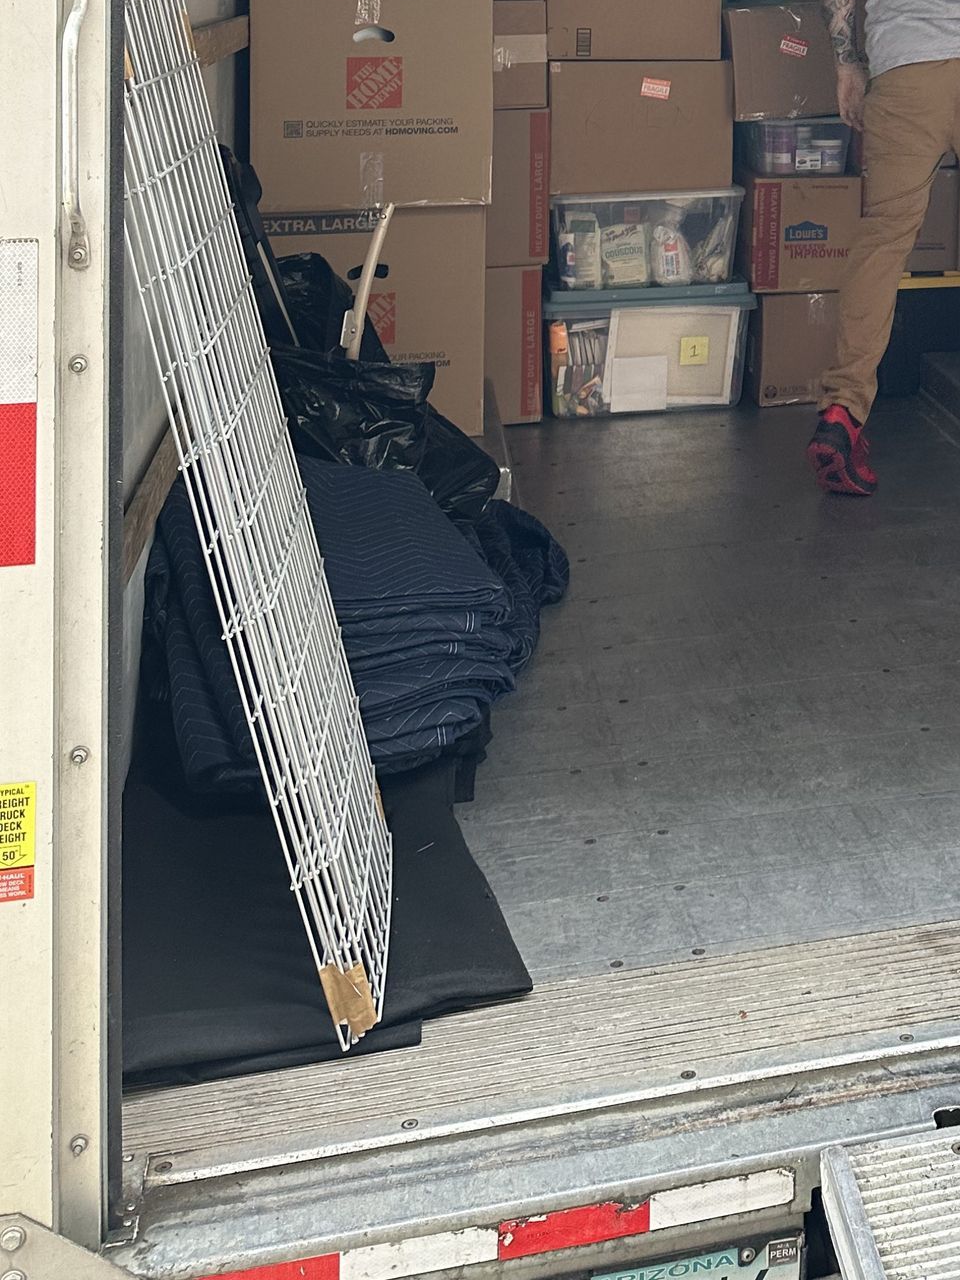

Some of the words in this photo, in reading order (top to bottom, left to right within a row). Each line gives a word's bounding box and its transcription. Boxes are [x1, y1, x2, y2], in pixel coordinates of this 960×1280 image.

[782, 41, 806, 54] FRAGILE
[353, 62, 376, 84] THE
[346, 57, 402, 109] HOME
[368, 77, 402, 109] DEPOT
[306, 120, 344, 128] QUICKLY
[346, 119, 387, 128] ESTIMATE
[389, 118, 414, 127] YOUR
[416, 118, 454, 126] PACKING
[306, 128, 340, 138] SUPPLY
[342, 128, 371, 136] NEEDS
[373, 128, 383, 136] AT
[385, 126, 458, 136] HDMOVING.COM
[536, 152, 544, 192] LARGE
[535, 194, 543, 220] DUTY
[263, 219, 316, 233] EXTRA
[535, 221, 543, 252] HEAVY
[789, 228, 824, 240] LOWE'S
[527, 310, 536, 350] LARGE
[690, 344, 700, 358] 1
[527, 352, 536, 378] DUTY
[0, 788, 24, 796] YPICAL
[0, 796, 30, 809] EIGHT
[0, 809, 26, 820] RUCK
[0, 832, 26, 844] EIGHT
[770, 1247, 797, 1259] PERM
[608, 1255, 734, 1280] RIZONA
